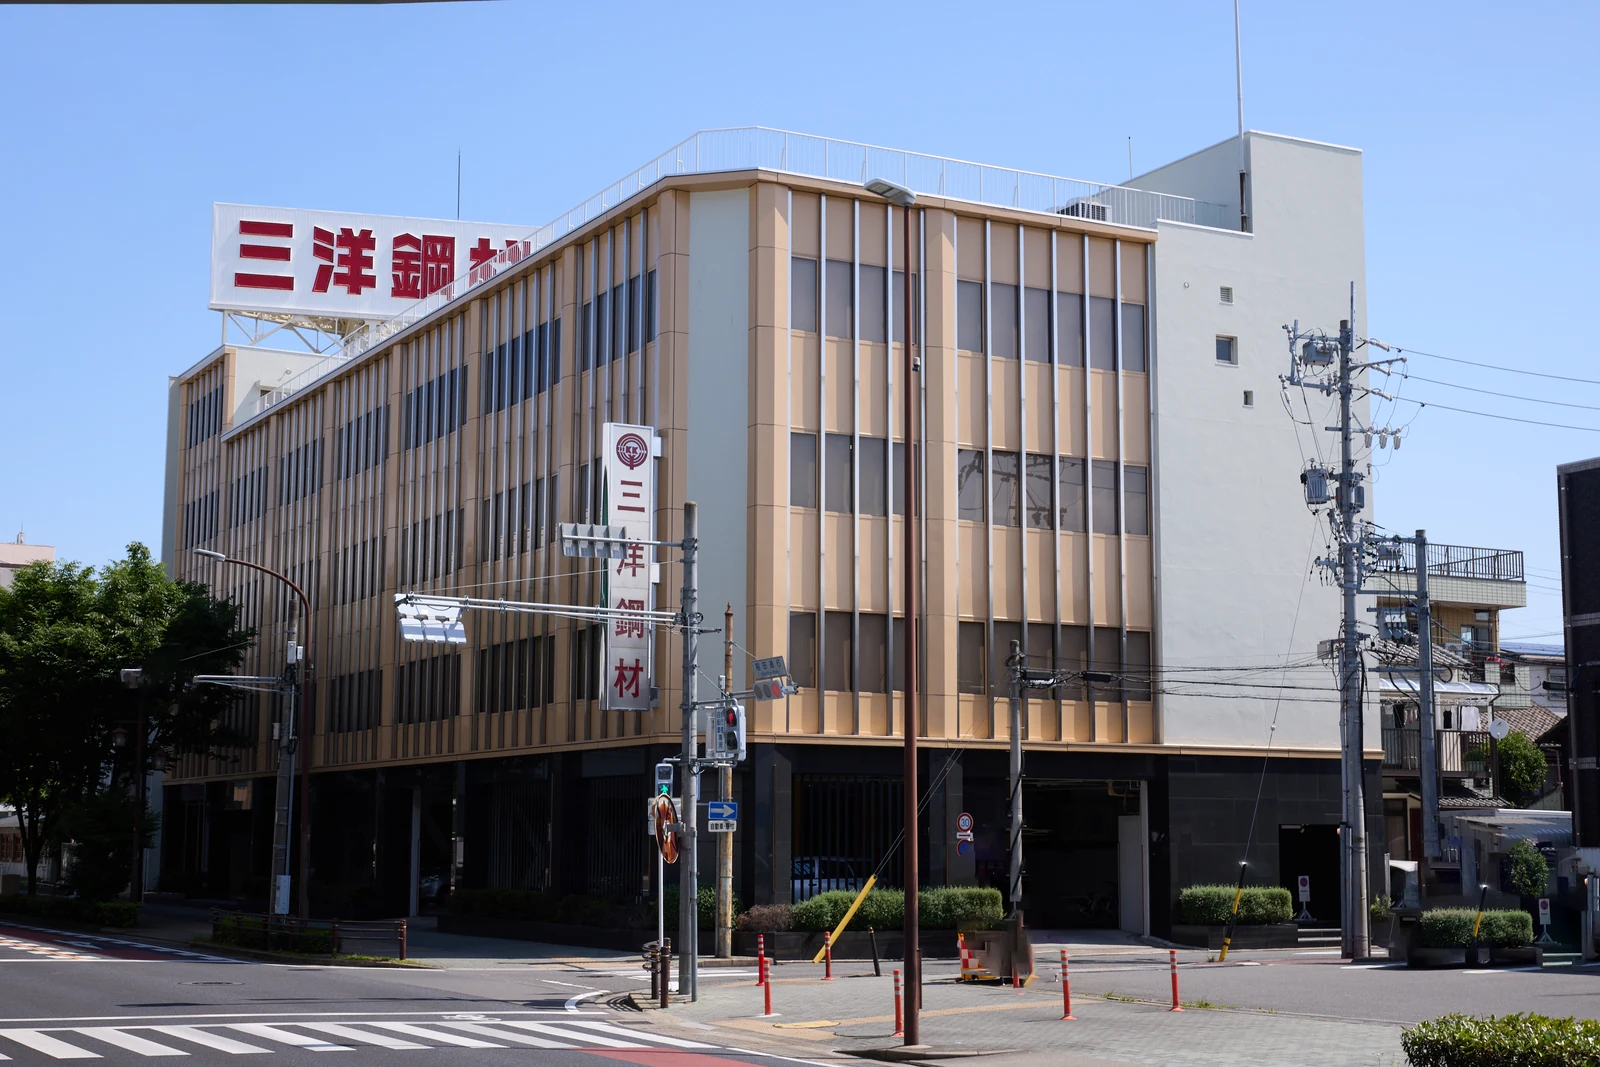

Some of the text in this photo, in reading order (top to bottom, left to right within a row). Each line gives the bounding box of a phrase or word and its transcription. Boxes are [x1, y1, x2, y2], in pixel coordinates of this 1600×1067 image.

[614, 479, 645, 698] 三洋鋼材
[960, 818, 970, 827] 30
